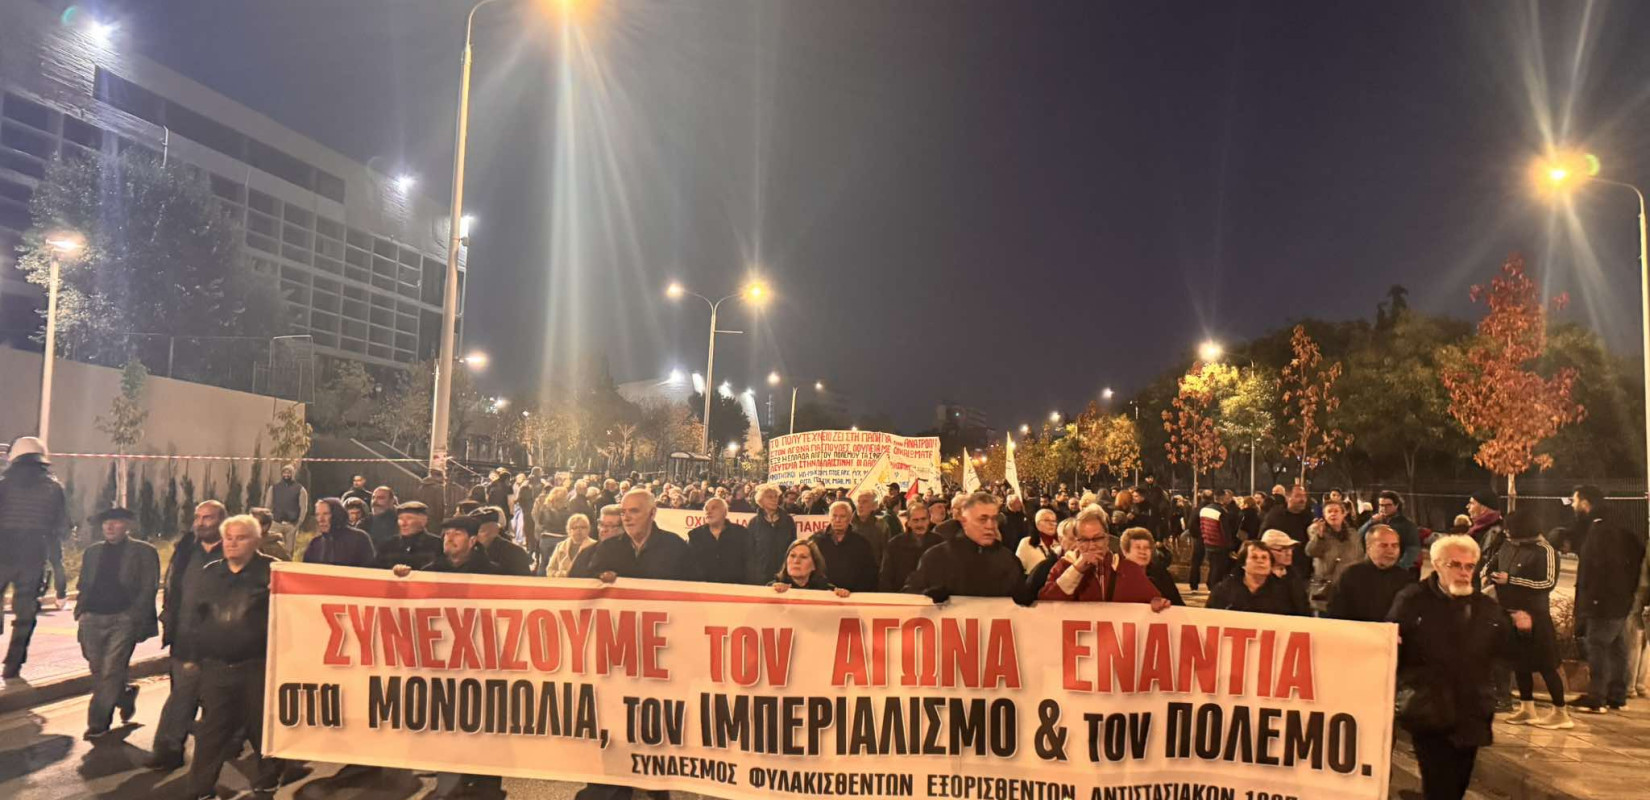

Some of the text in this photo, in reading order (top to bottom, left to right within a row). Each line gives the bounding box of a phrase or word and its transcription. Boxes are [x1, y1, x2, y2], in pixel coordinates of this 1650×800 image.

[321, 603, 669, 679] ΣΥΝΕΧΙΖΟΥΜΕ
[831, 617, 1021, 689] ΑΓΩΝΑ
[1061, 619, 1315, 701] ΕΝΑΝΤΙΑ
[278, 681, 341, 728] στα
[368, 675, 610, 750] ΜΟΝΟΠΩΛΙΑ,
[700, 692, 1016, 758] ΙΜΠΕΡΙΑΛΙΣΜΟ
[1033, 699, 1068, 761] &
[1165, 701, 1373, 777] ΠΟΛΕΜΟ.
[631, 753, 737, 785] ΣΥΝΔΕΣΜΟΣ
[749, 767, 914, 795] ΦΥΛΑΚΙΣΘΕΝΤΩΝ
